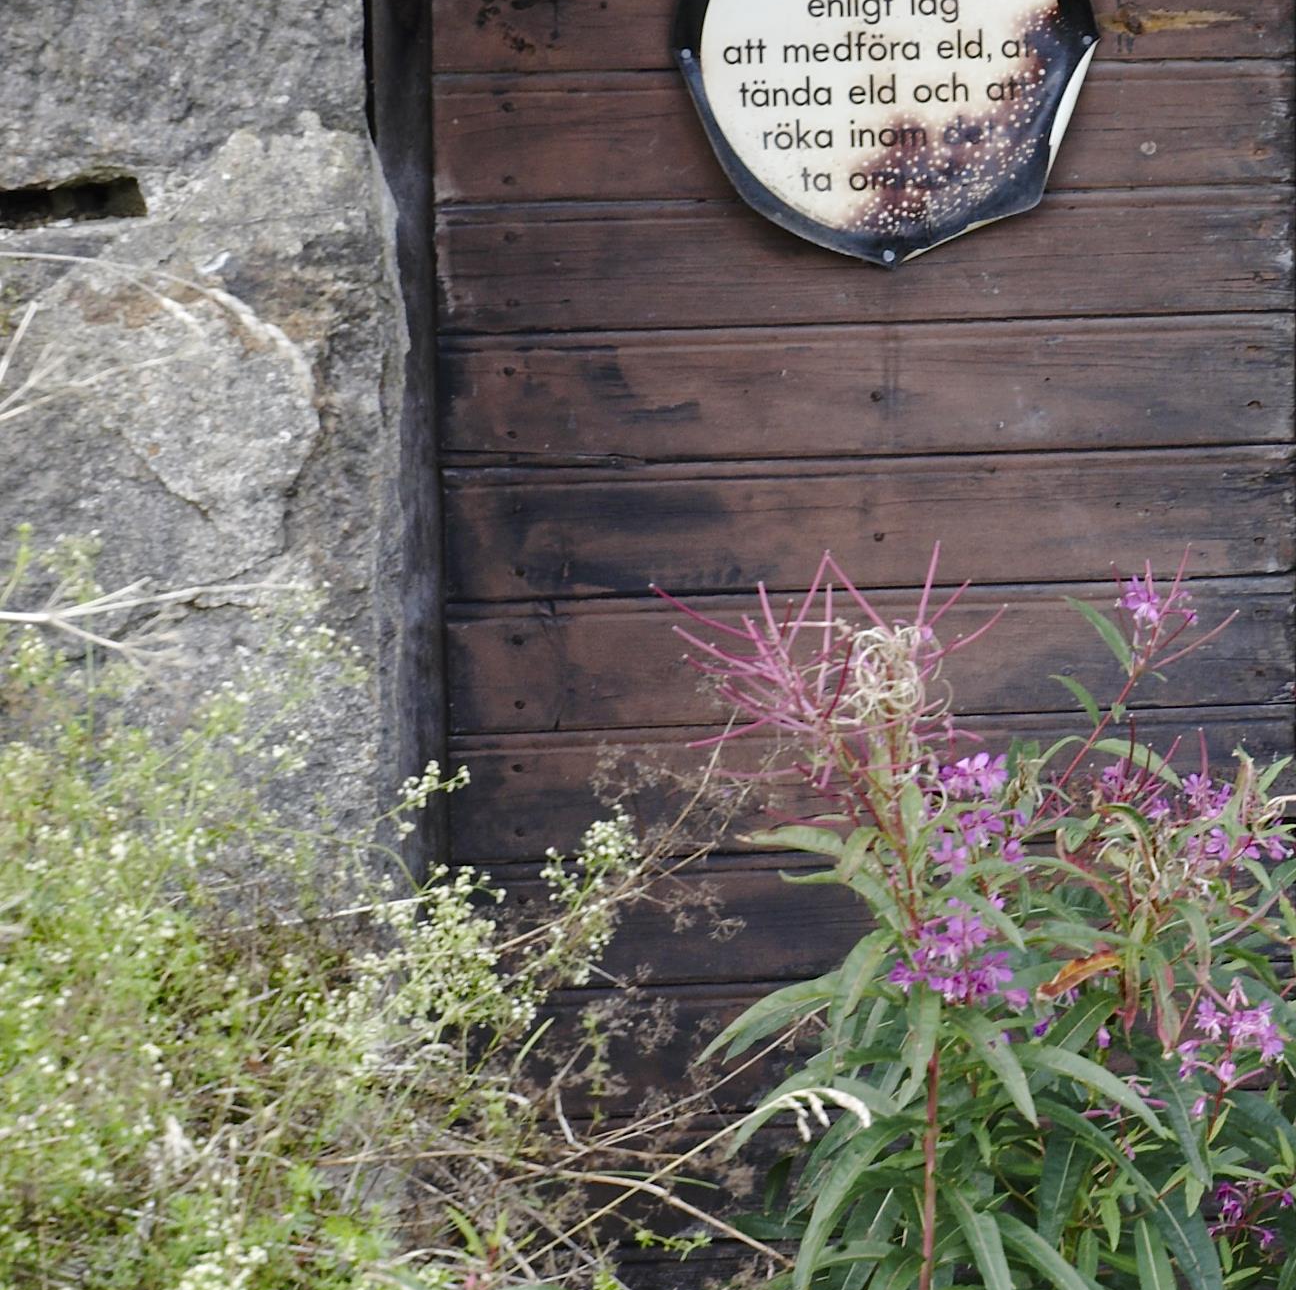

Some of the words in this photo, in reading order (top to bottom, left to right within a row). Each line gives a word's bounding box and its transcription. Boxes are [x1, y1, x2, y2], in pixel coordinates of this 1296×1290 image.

[722, 38, 767, 65] att
[783, 31, 921, 64] medföra
[936, 28, 993, 62] eld,
[738, 76, 833, 108] tända
[848, 73, 897, 106] eld
[913, 72, 970, 104] och
[762, 119, 834, 151] röka
[849, 120, 928, 149] inom
[801, 165, 833, 193] ta
